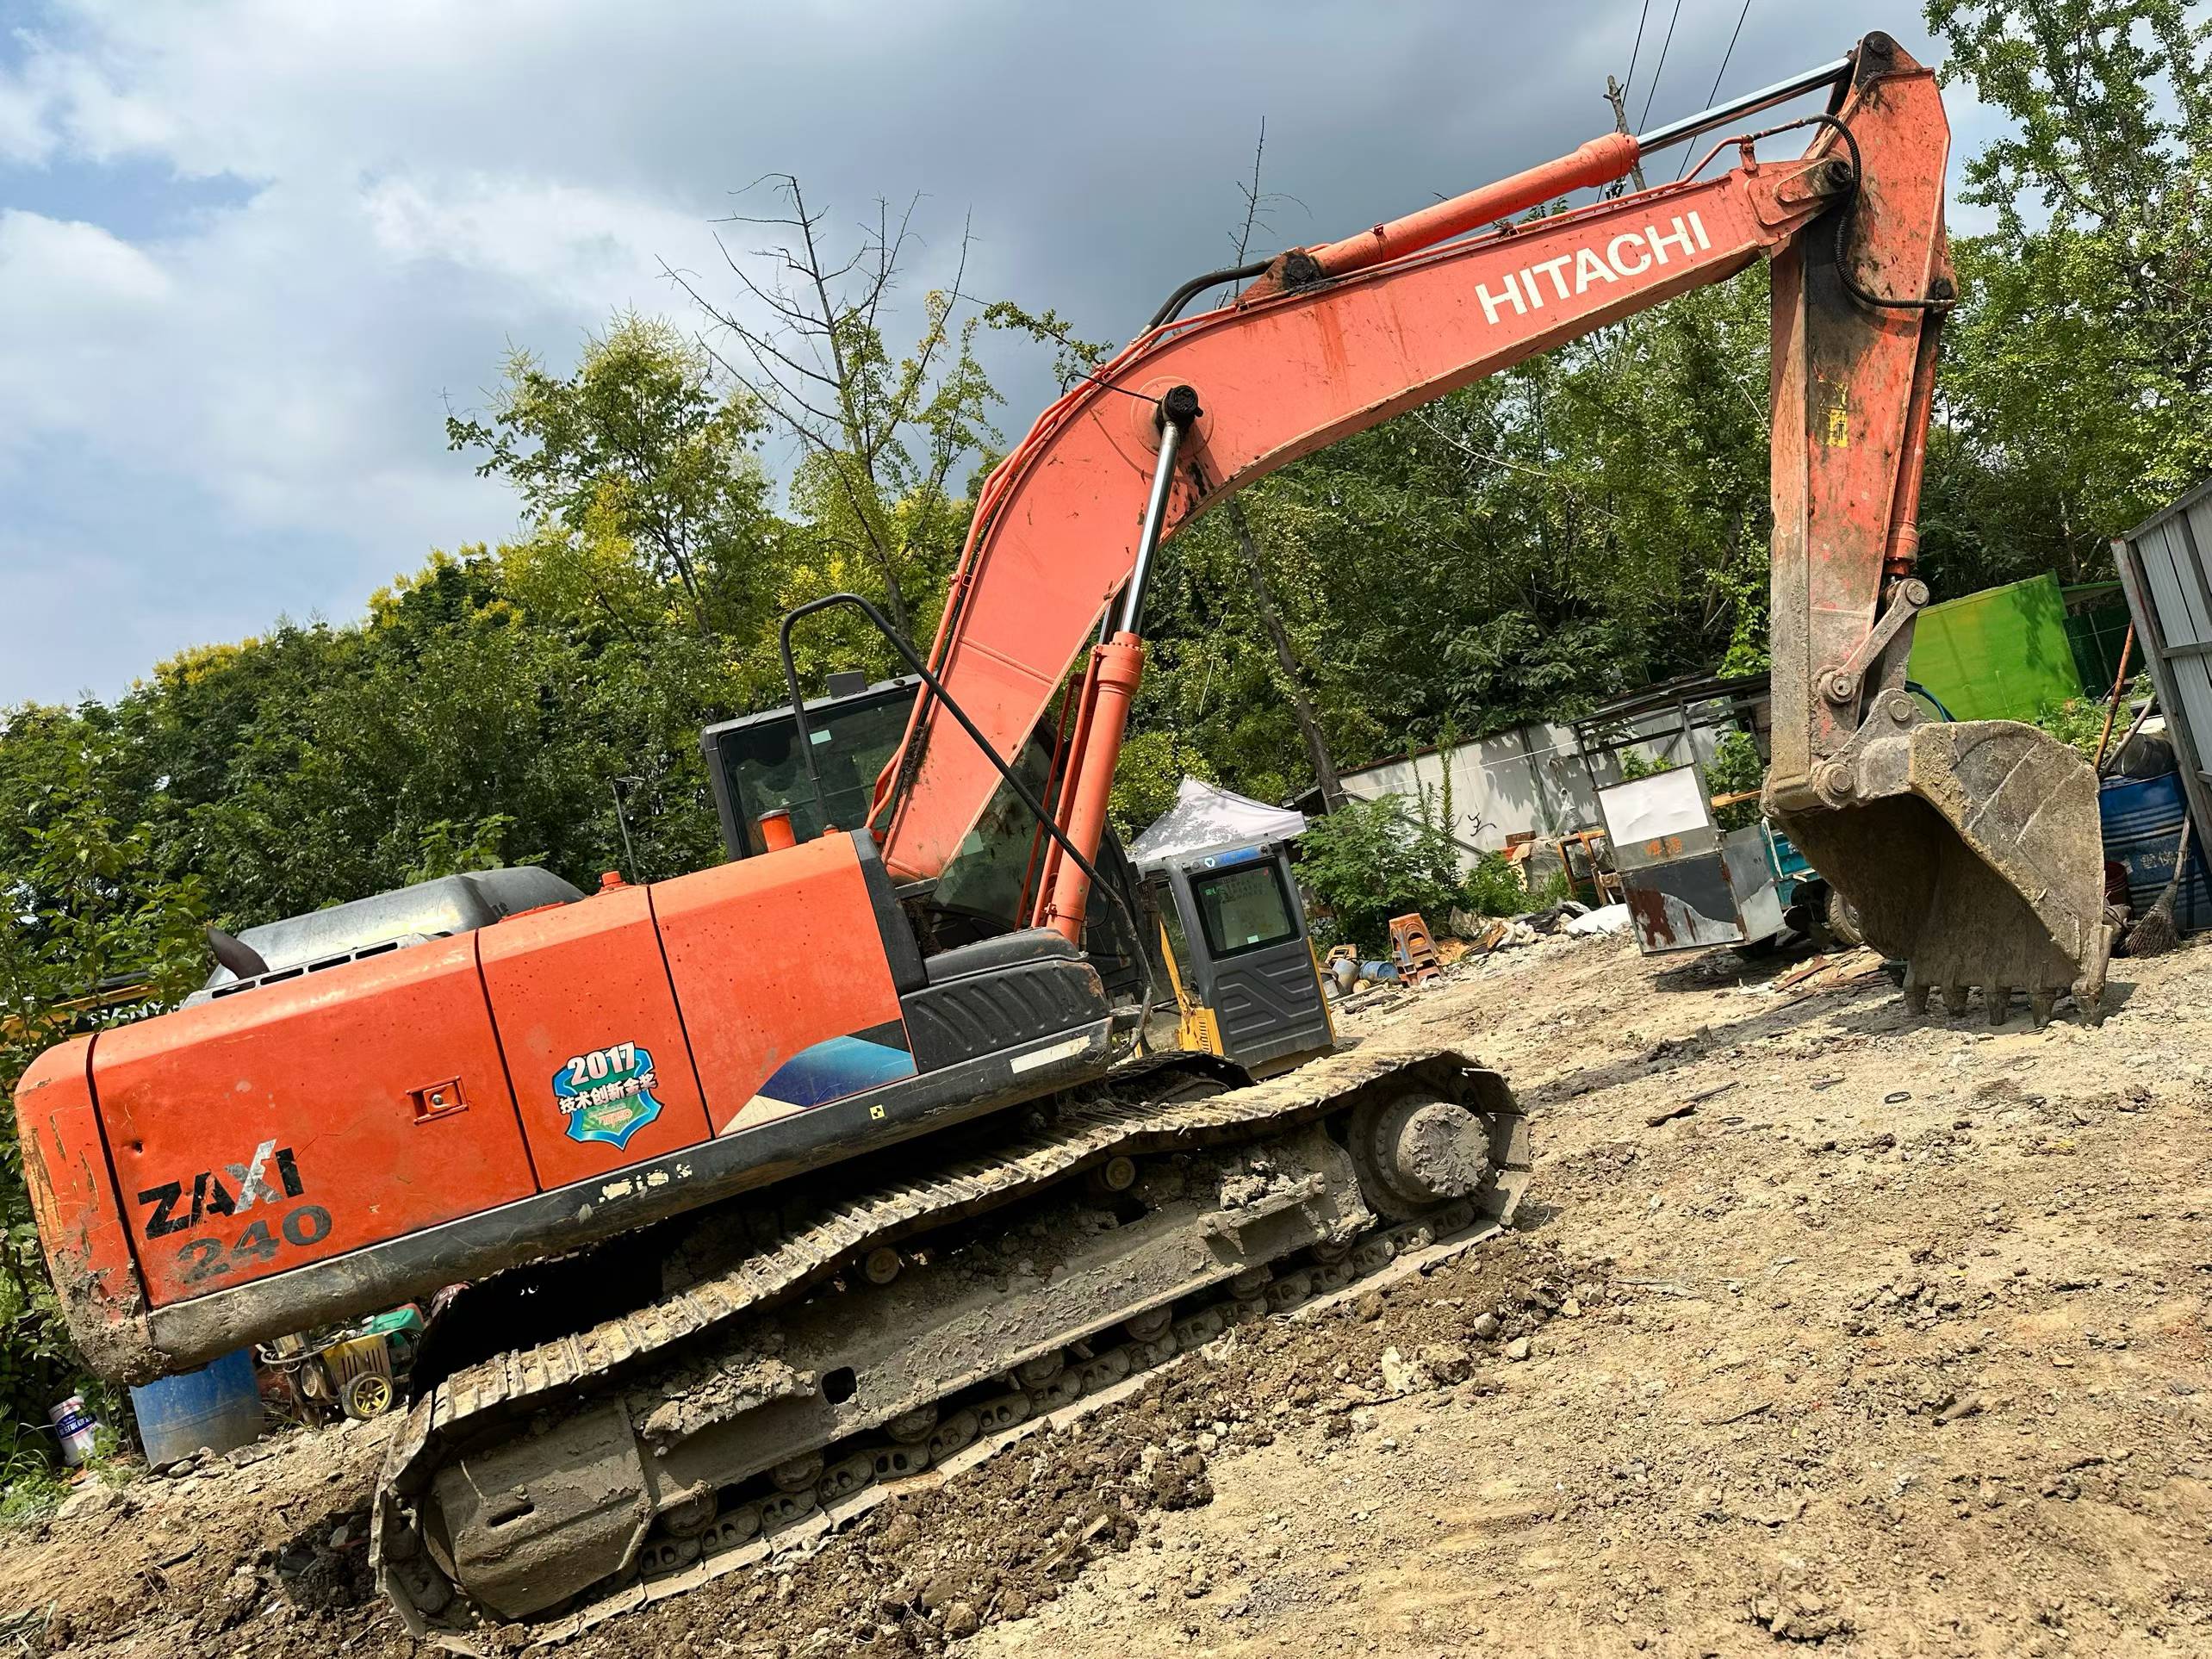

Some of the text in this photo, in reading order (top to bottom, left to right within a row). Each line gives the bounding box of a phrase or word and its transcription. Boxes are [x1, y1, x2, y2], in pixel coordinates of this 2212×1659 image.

[1475, 210, 1712, 325] HITACHI
[558, 1072, 658, 1114] 技术创新金奖
[566, 1041, 636, 1086] 2017
[137, 1138, 305, 1240] ZAXI
[177, 1204, 333, 1284] 240
